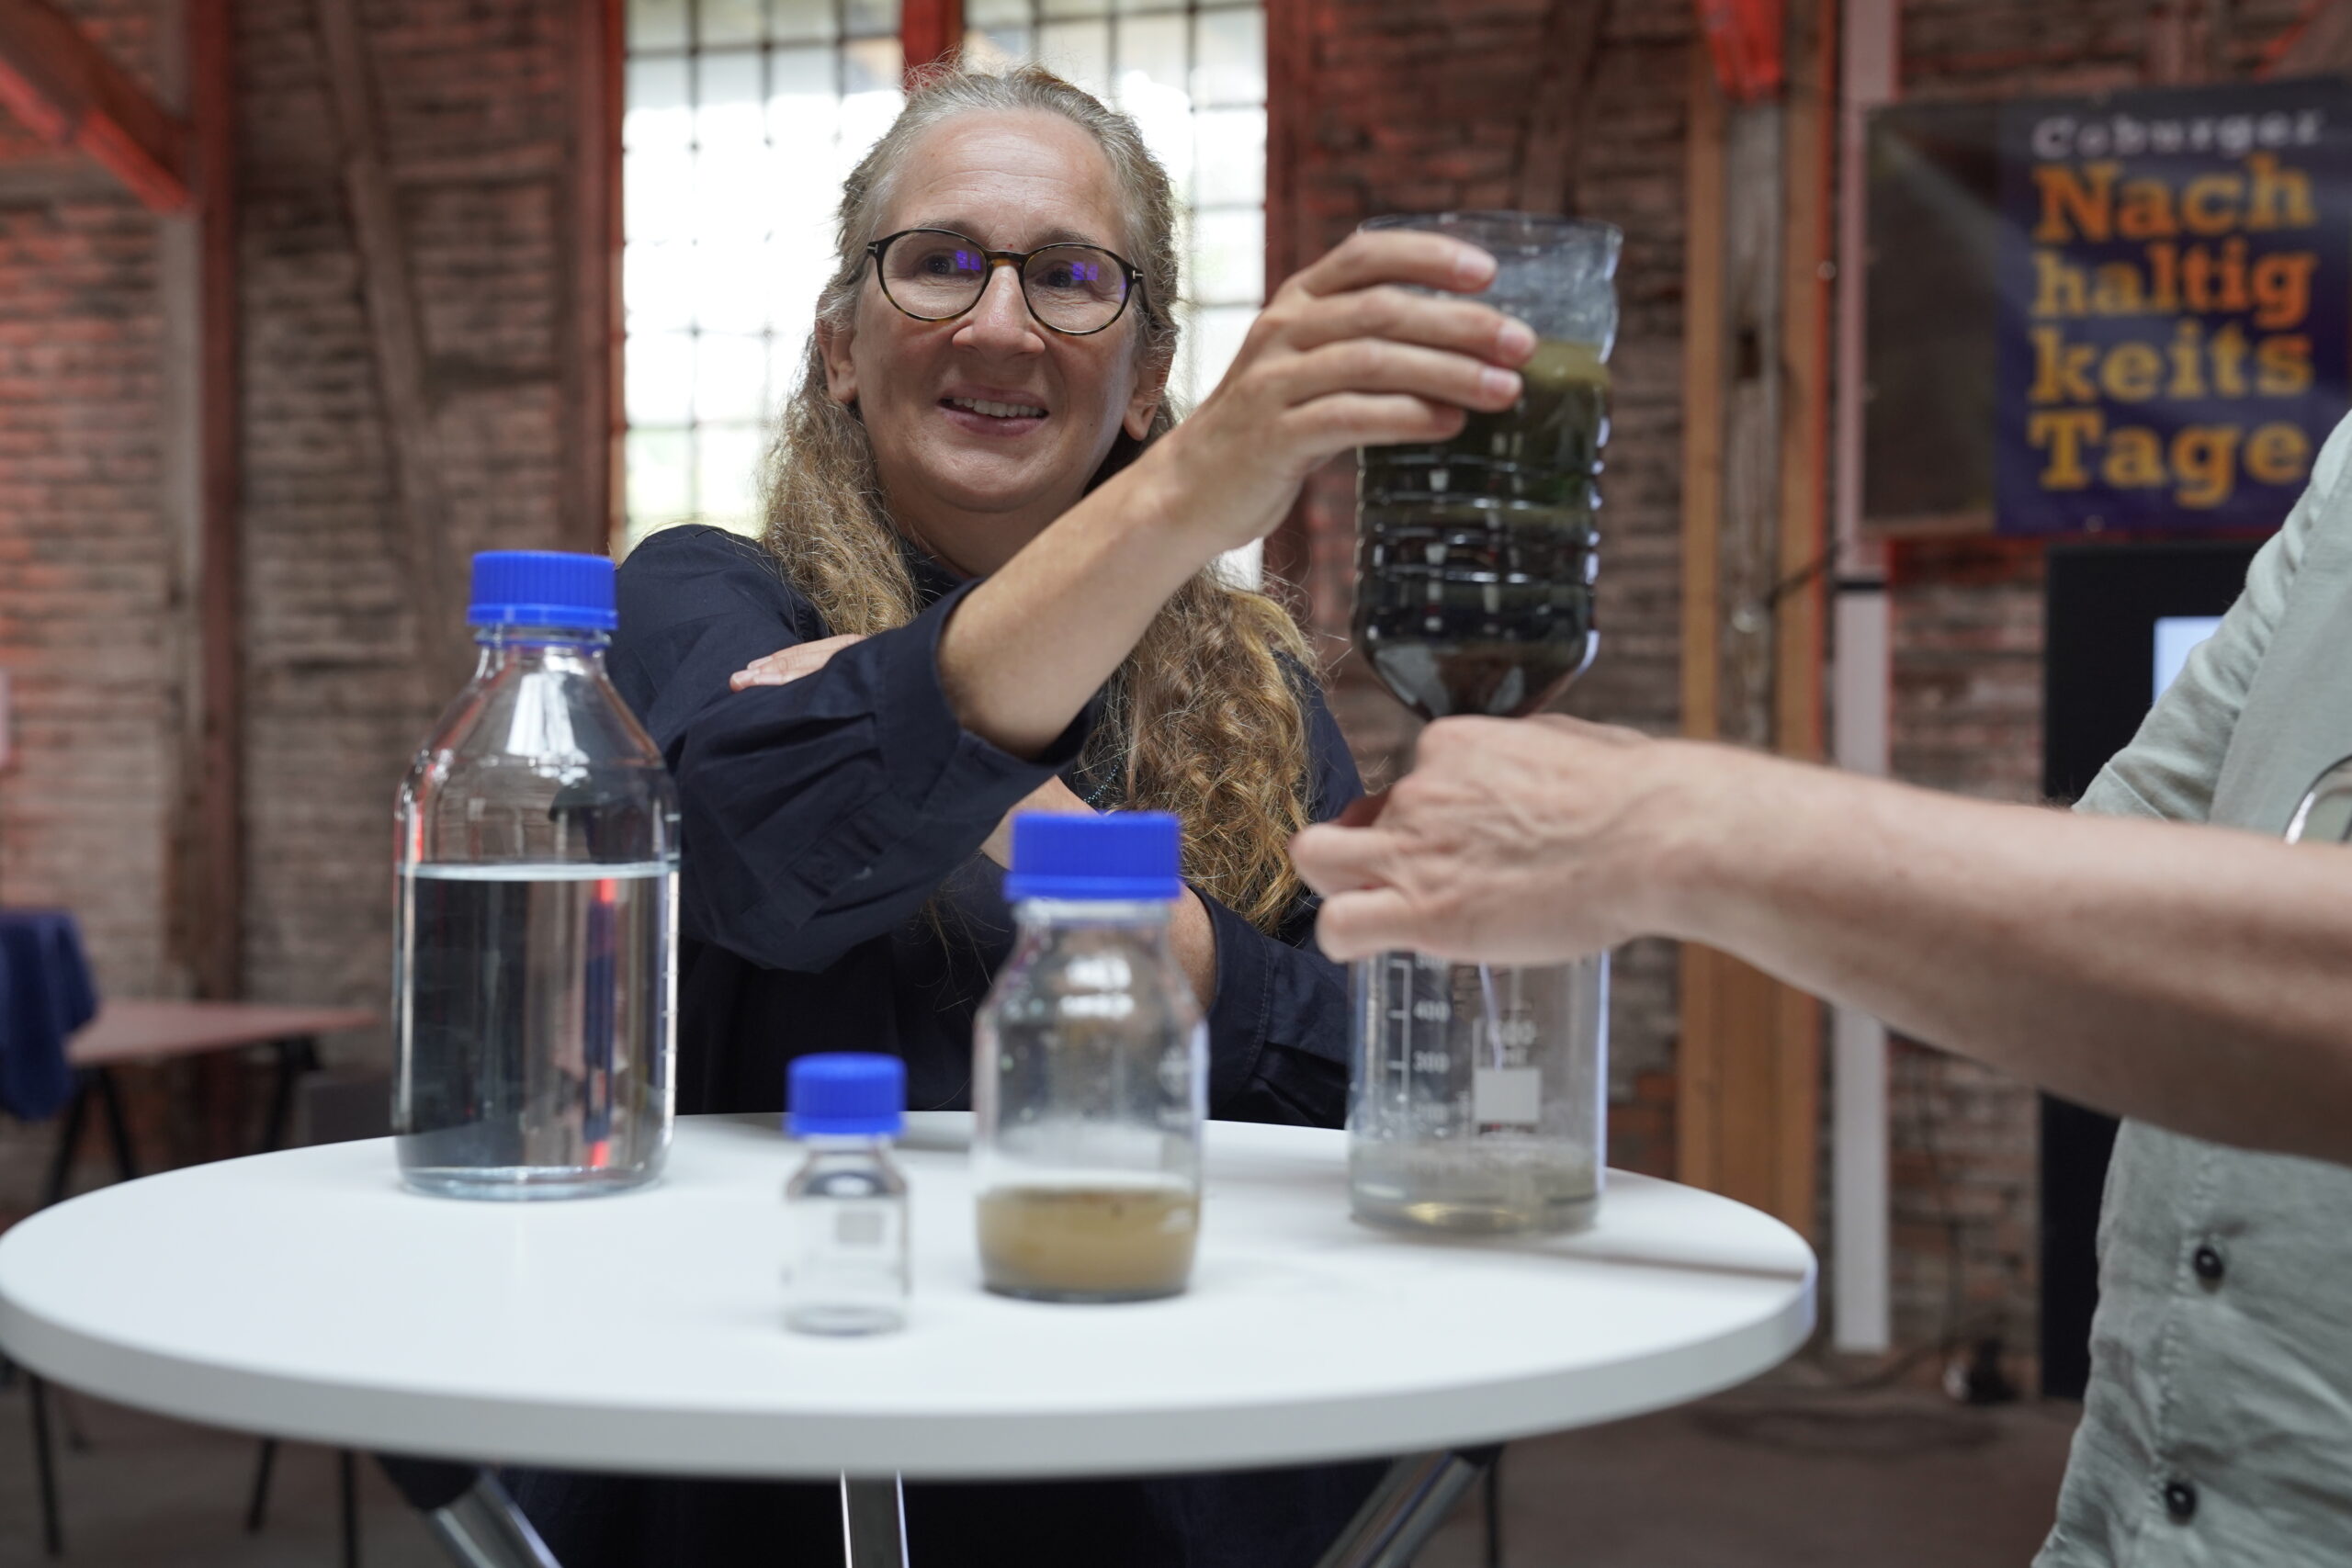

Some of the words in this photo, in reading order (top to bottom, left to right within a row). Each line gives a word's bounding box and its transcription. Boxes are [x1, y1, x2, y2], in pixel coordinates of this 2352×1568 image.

[2031, 109, 2324, 158] Coburger
[2032, 152, 2316, 243] Nach
[2032, 237, 2316, 329] haltig
[2030, 321, 2313, 402] keits
[2028, 409, 2310, 507] Tage
